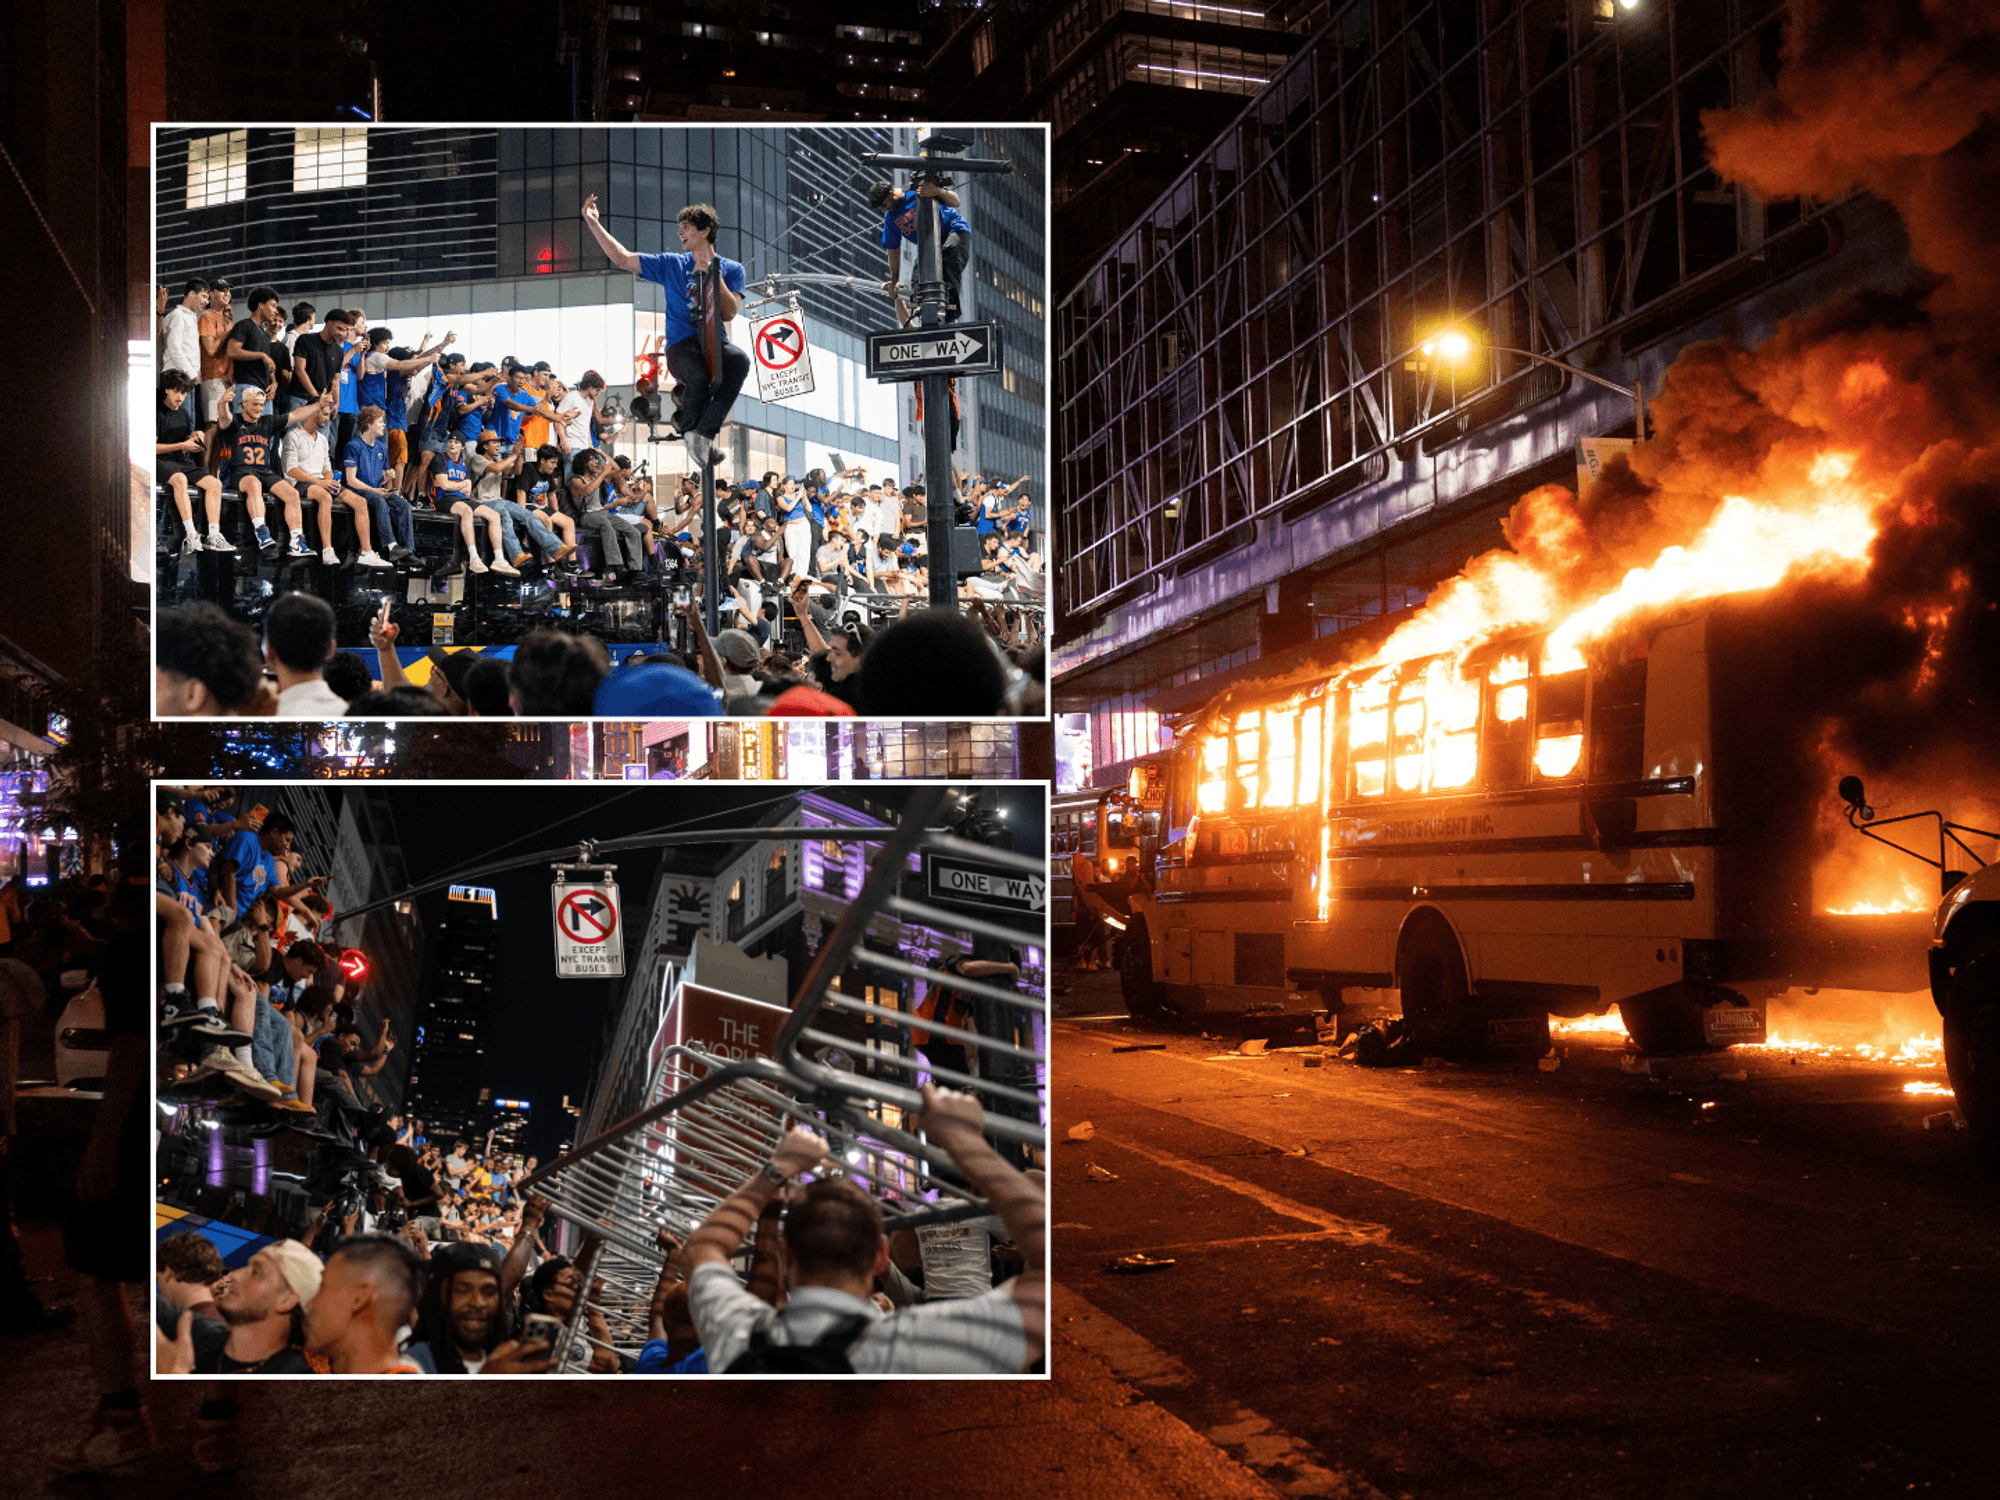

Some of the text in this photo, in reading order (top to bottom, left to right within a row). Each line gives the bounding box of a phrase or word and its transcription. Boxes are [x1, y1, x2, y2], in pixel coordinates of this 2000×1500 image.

[890, 339, 971, 360] ONE WAY
[762, 373, 810, 391] NYC TRANSIT
[770, 367, 798, 381] EXCEPT
[774, 384, 800, 397] BUSES
[243, 446, 265, 465] 32
[1384, 821, 1414, 839] FIRST
[1415, 816, 1468, 838] STUDENT
[951, 871, 989, 893] ONE
[1006, 880, 1046, 901] WAY
[561, 955, 619, 963] NYC TRANSIT
[572, 946, 607, 954] EXCEPT
[575, 964, 607, 972] BUSES
[718, 1017, 760, 1048] THE
